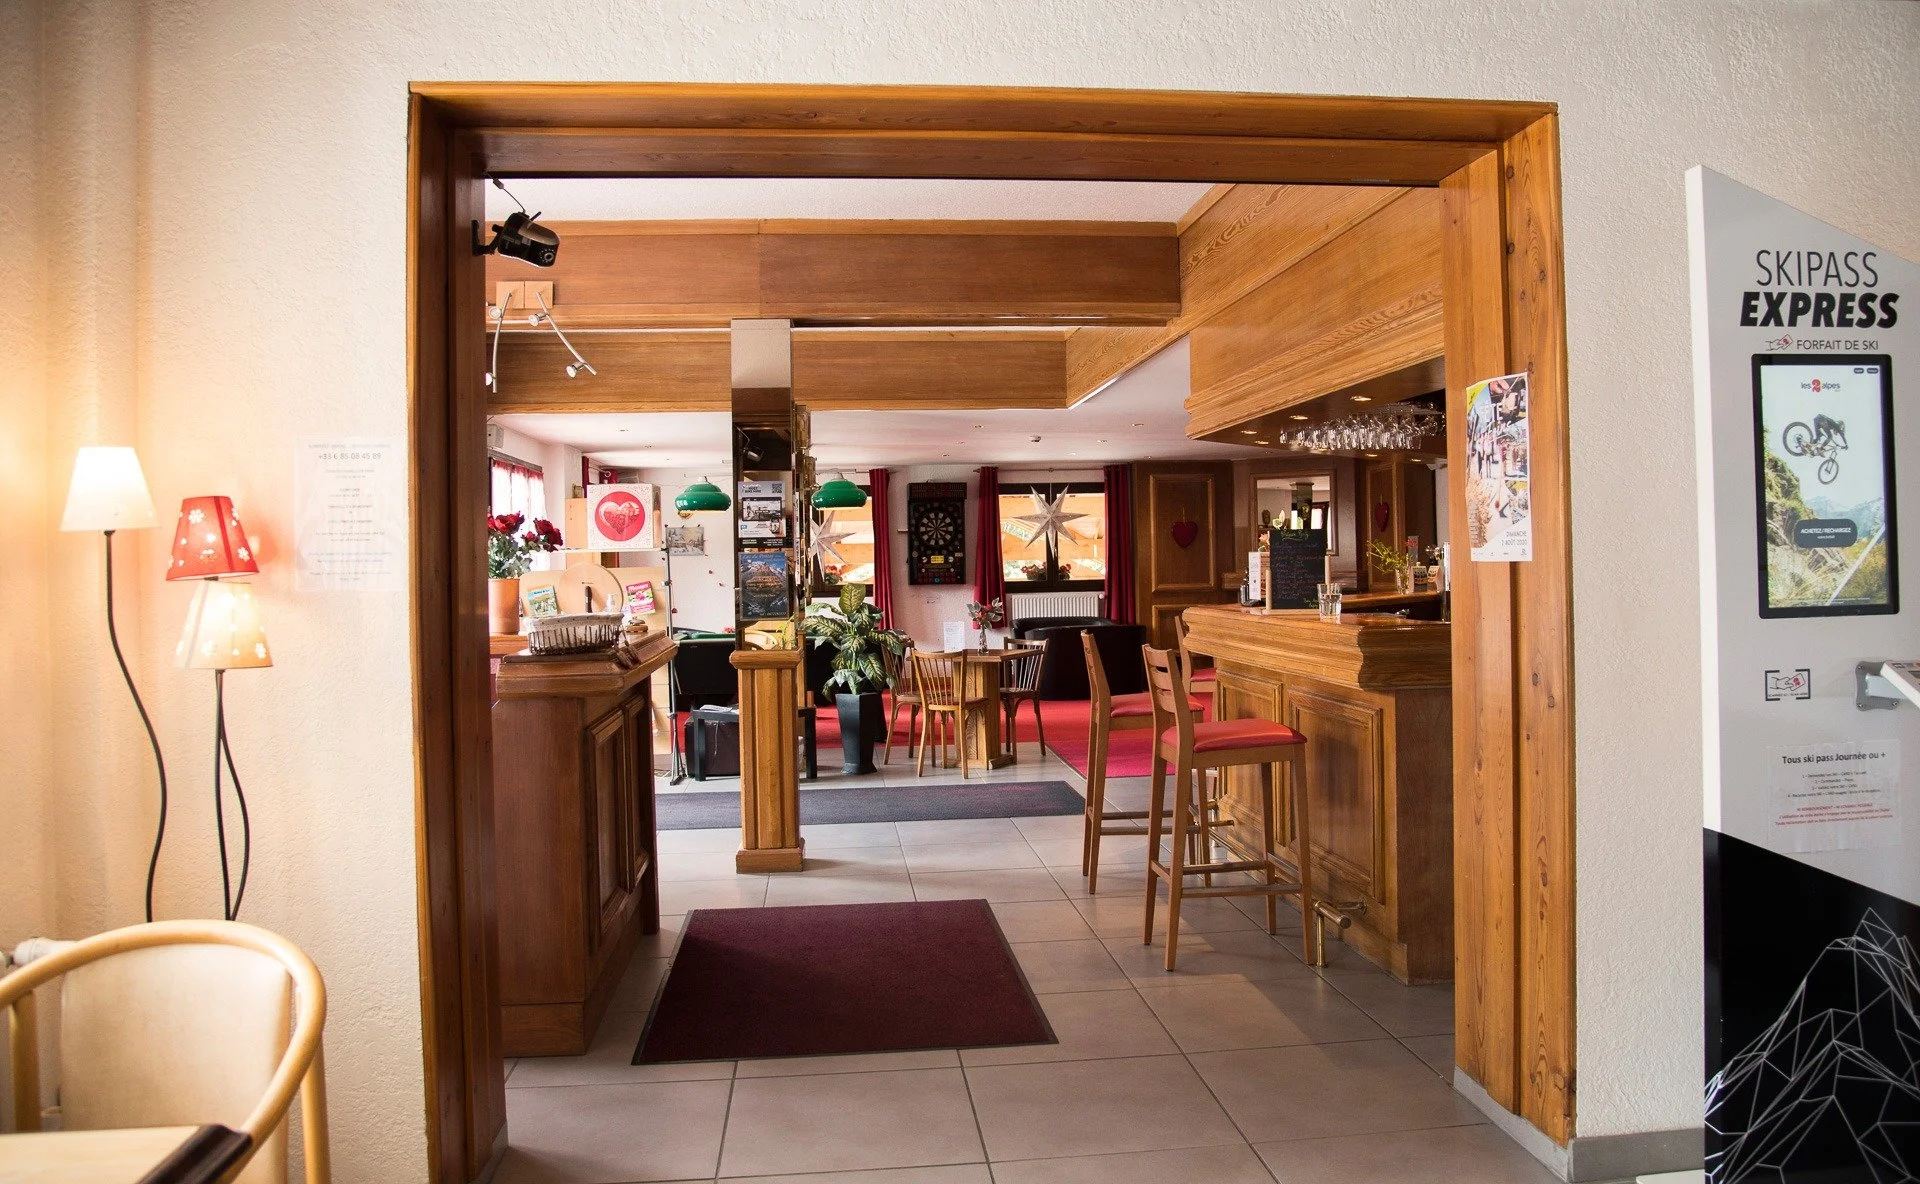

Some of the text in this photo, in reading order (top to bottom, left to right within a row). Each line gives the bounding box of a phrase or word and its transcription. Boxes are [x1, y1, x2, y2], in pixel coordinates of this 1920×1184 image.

[1756, 250, 1878, 288] SKIPASS
[1740, 291, 1899, 328] EXPRESS
[1796, 340, 1879, 350] FORFAIT DE SKI
[1782, 756, 1801, 764] Tous
[1803, 755, 1814, 763] ski
[1816, 755, 1834, 764] pass
[1836, 752, 1867, 761] Journée
